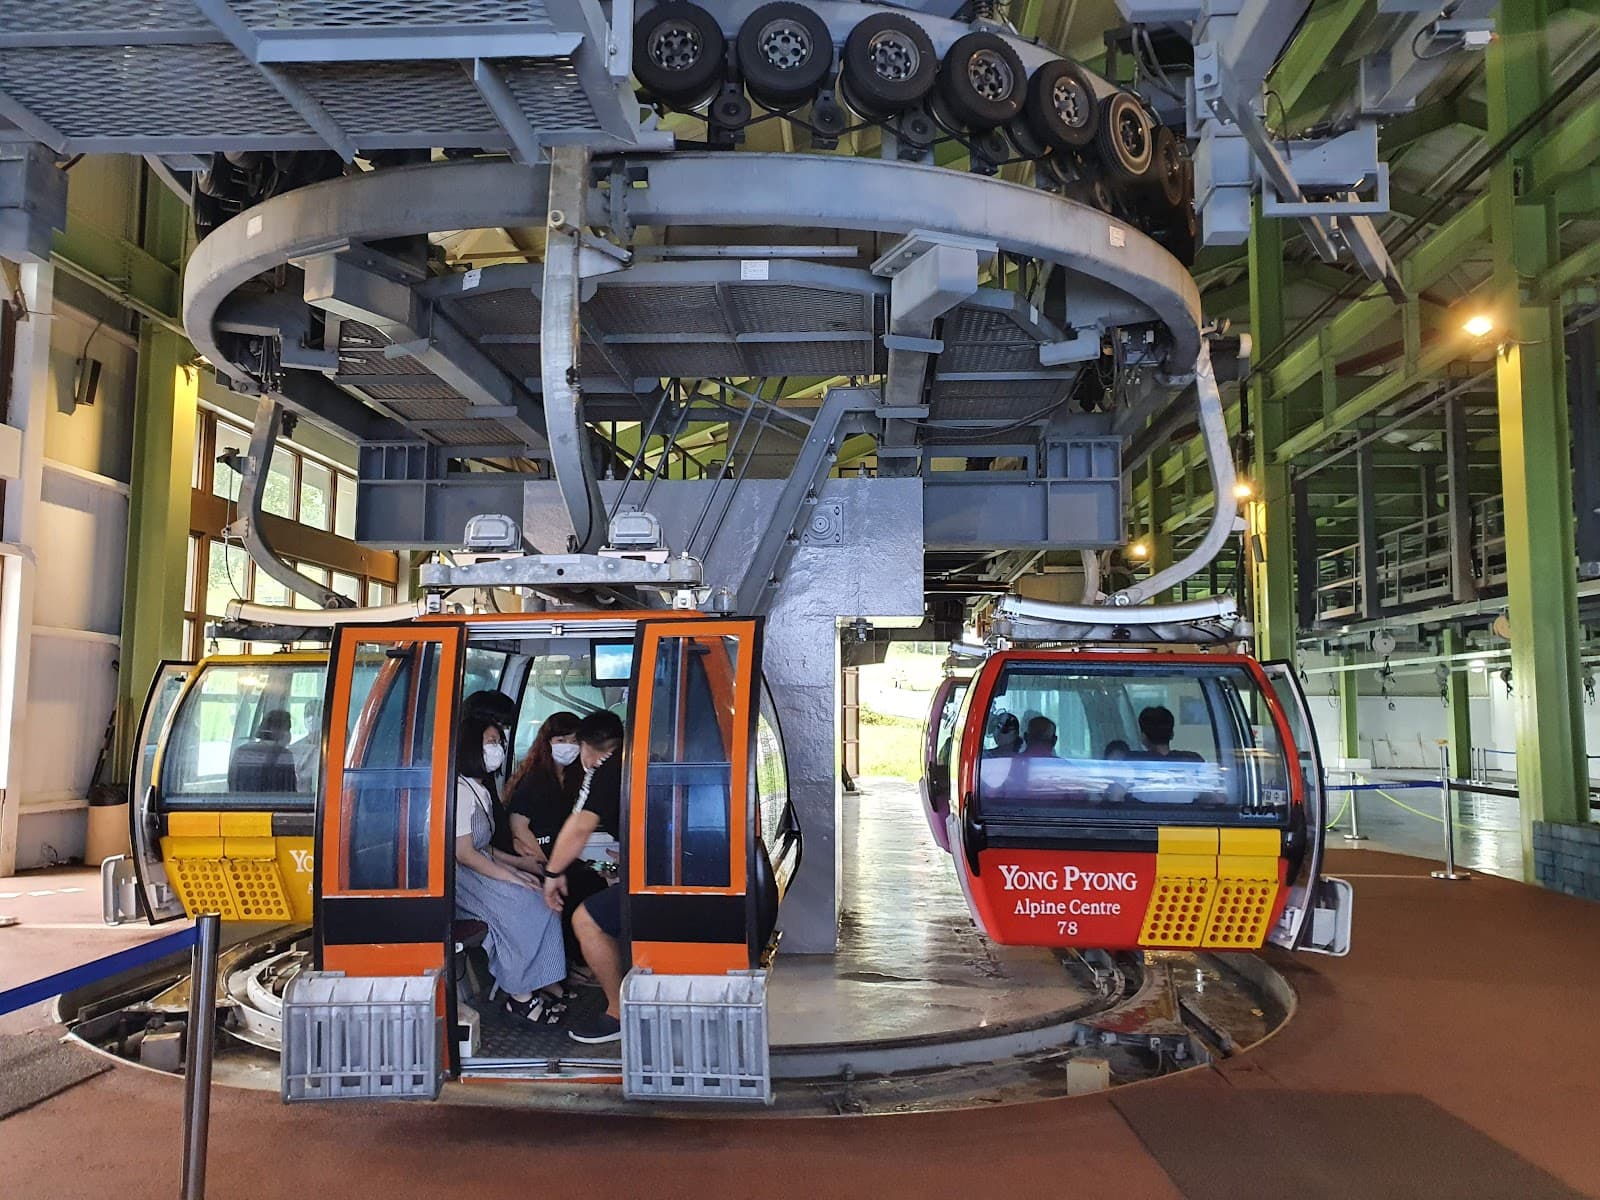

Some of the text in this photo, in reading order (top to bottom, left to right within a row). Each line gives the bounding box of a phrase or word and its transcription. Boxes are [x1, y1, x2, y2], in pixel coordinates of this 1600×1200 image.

[288, 849, 314, 873] YO
[998, 865, 1138, 891] YONG PYONG
[1014, 898, 1121, 918] Alpine Centre
[1057, 921, 1078, 935] 78
